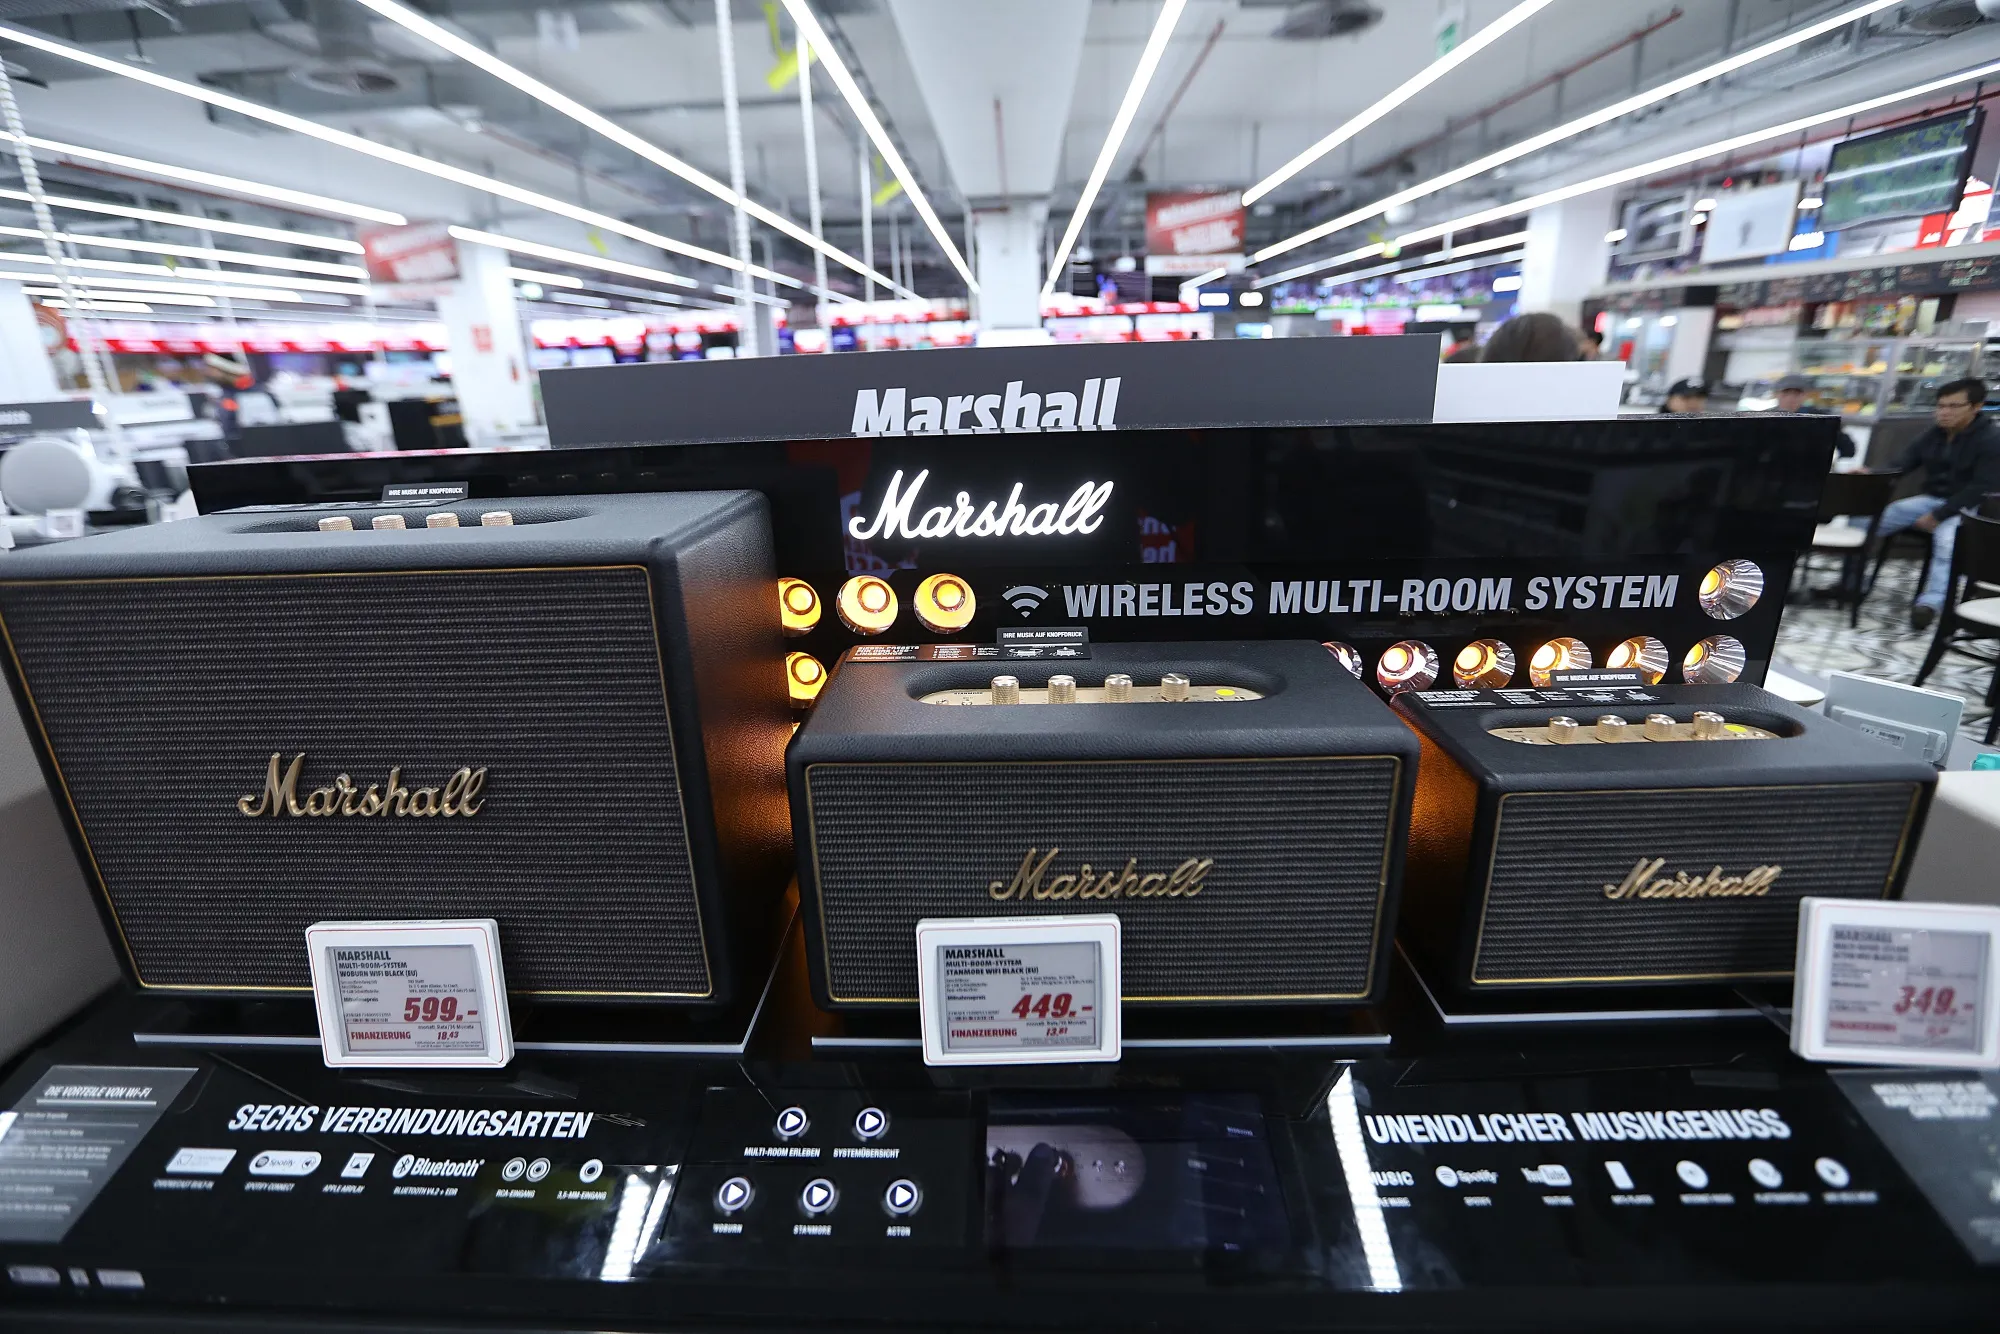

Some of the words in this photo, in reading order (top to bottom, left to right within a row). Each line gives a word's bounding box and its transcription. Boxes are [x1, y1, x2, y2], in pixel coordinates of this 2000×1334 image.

[851, 376, 1122, 434] Marshall
[849, 469, 1114, 540] Marshall
[1063, 580, 1254, 618] WIRELESS
[1269, 578, 1512, 614] MULTI-ROOM
[1525, 575, 1680, 611] SYSTEM
[238, 752, 488, 818] Marshall
[989, 847, 1214, 900] Marshall
[1603, 857, 1782, 899] Marshall
[338, 950, 391, 961] MARSHALL
[945, 949, 1005, 959] MARSHALL
[946, 959, 1022, 967] MULTI-ROOM-SYSTEM
[406, 970, 418, 978] (EU)
[946, 967, 984, 976] STANMORE
[1025, 967, 1039, 975] (EU)
[351, 1031, 411, 1040] FINANZIERUNG
[952, 1028, 1017, 1038] FINANZIERUNG
[44, 1086, 62, 1096] DIE
[62, 1086, 105, 1097] VORTEILE
[105, 1087, 128, 1097] VON
[126, 1087, 152, 1098] WI-FI
[228, 1104, 319, 1132] SECHS
[320, 1106, 594, 1138] VERBINDUNGSARTEN
[1365, 1112, 1574, 1144] UNENDLICHER
[1571, 1108, 1792, 1141] MUSIKGENUSS
[789, 1148, 820, 1158] ERLEBEN
[833, 1147, 899, 1158] SYSTEMÜBERSICHT
[393, 1186, 427, 1195] BLUETOOTH
[794, 1224, 832, 1235] STANMORE
[887, 1226, 911, 1236] ACTON
